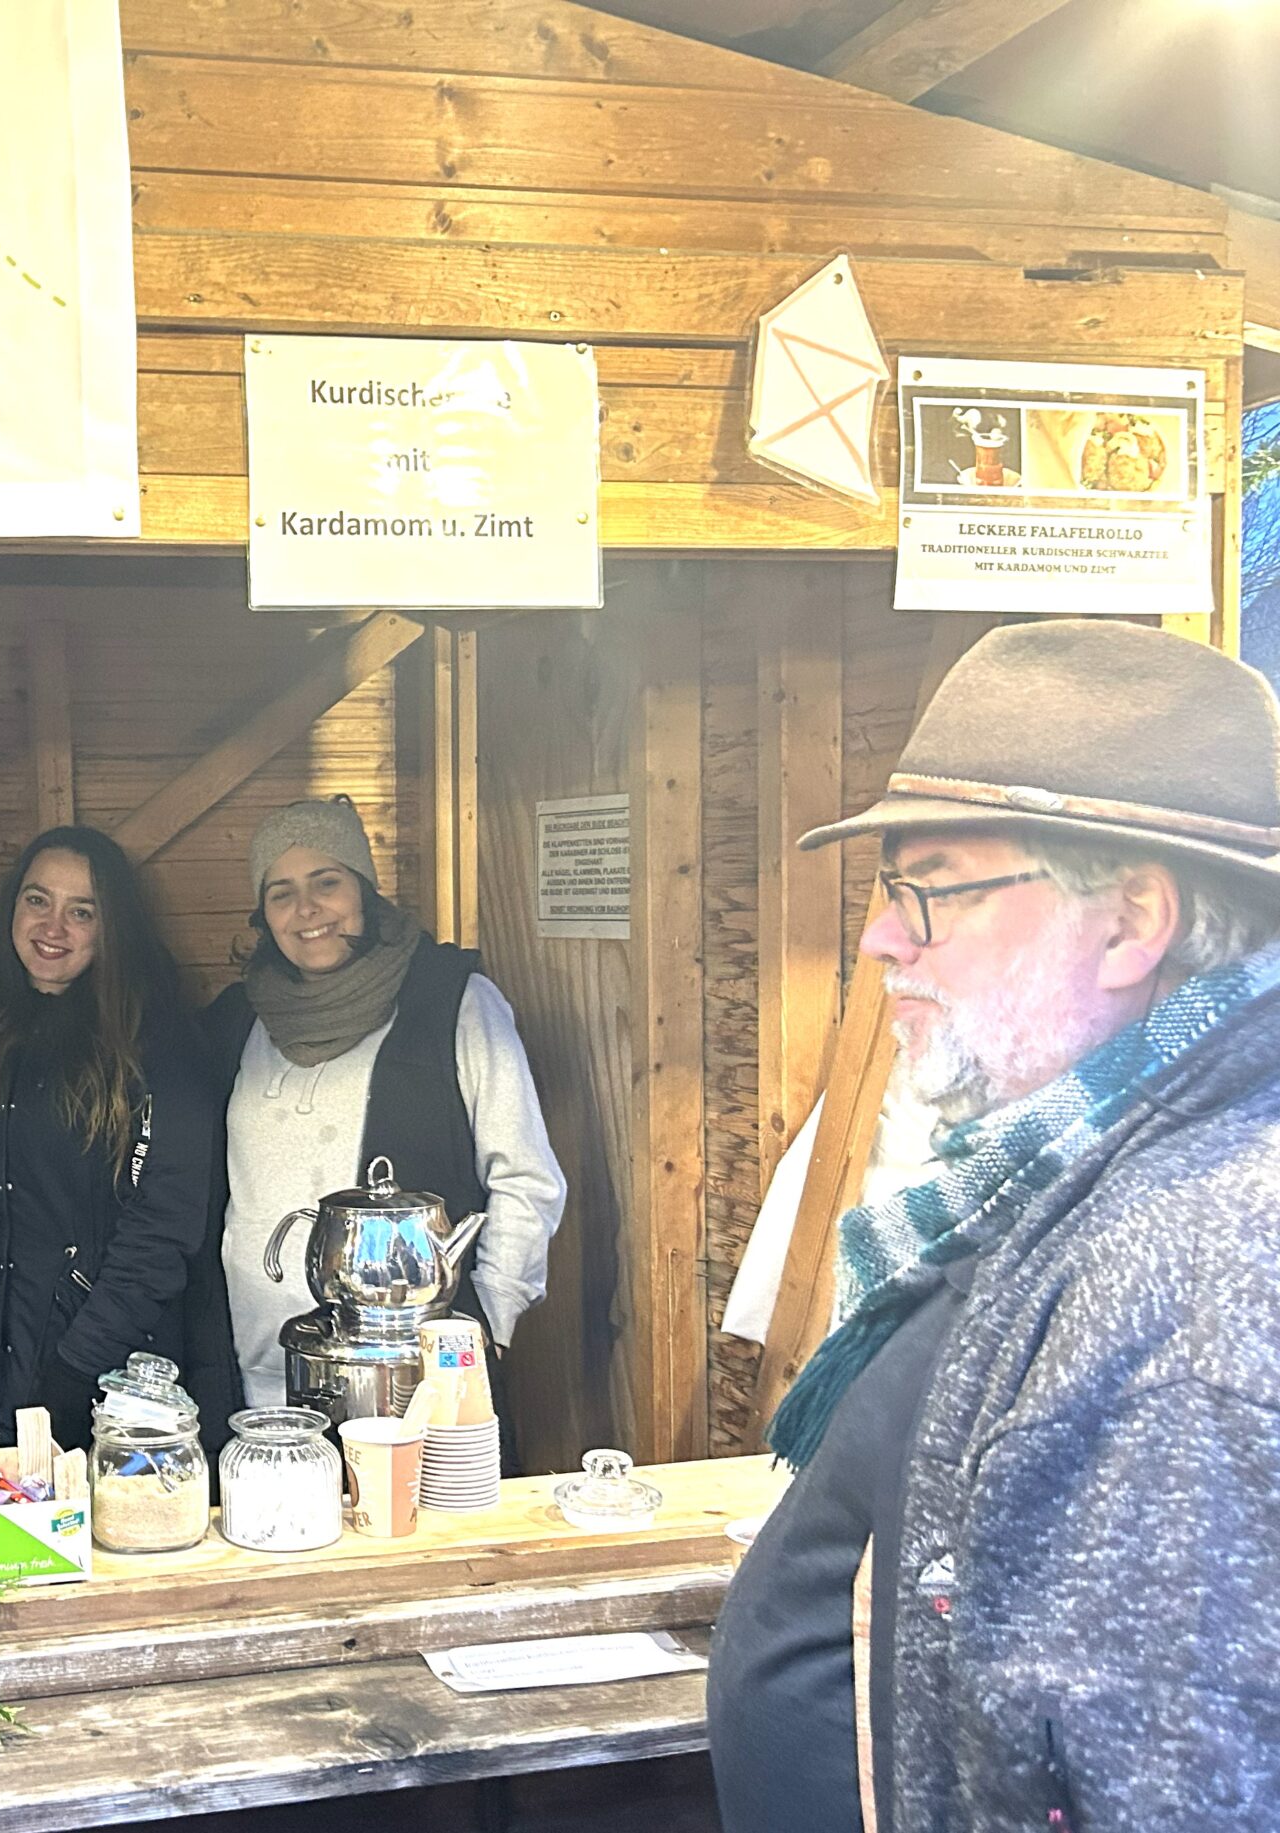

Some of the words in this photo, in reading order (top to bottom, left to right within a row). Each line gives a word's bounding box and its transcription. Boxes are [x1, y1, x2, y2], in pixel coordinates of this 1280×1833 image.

[386, 448, 431, 472] mit
[281, 511, 433, 537] Kardamom
[441, 519, 466, 537] u.
[474, 514, 535, 538] Zimt
[959, 523, 1027, 538] LECKERE
[1031, 526, 1143, 541] FALAFELROLLO
[920, 544, 1018, 556] TRADITIONELLER
[1022, 547, 1094, 558] KURDISCHER
[1096, 549, 1169, 560] SCHWARZTEE
[974, 562, 995, 571] MIT
[997, 562, 1062, 573] KARDAMOM
[1064, 565, 1089, 574] UND
[1091, 565, 1117, 574] ZIMT
